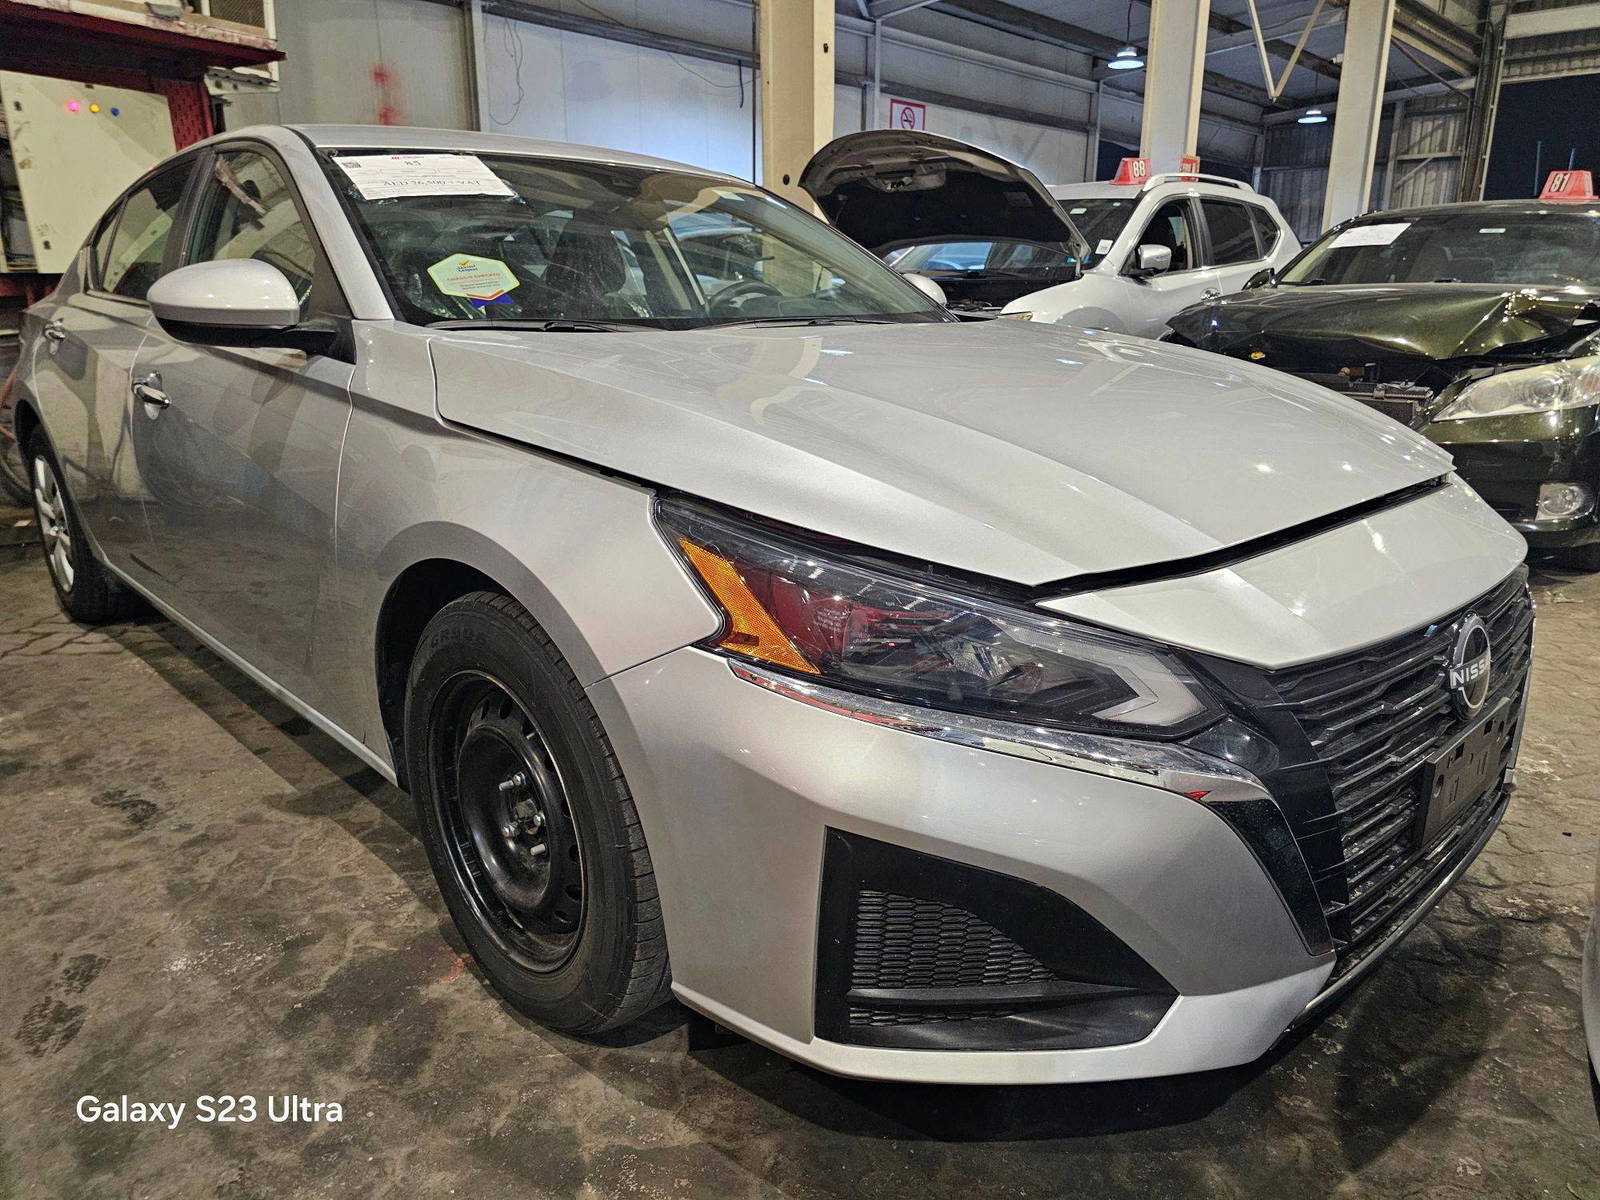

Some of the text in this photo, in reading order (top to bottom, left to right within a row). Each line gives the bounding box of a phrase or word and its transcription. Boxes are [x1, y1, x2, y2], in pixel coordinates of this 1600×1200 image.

[1133, 161, 1146, 178] 88
[1550, 173, 1571, 192] 81
[1450, 657, 1487, 687] NISS
